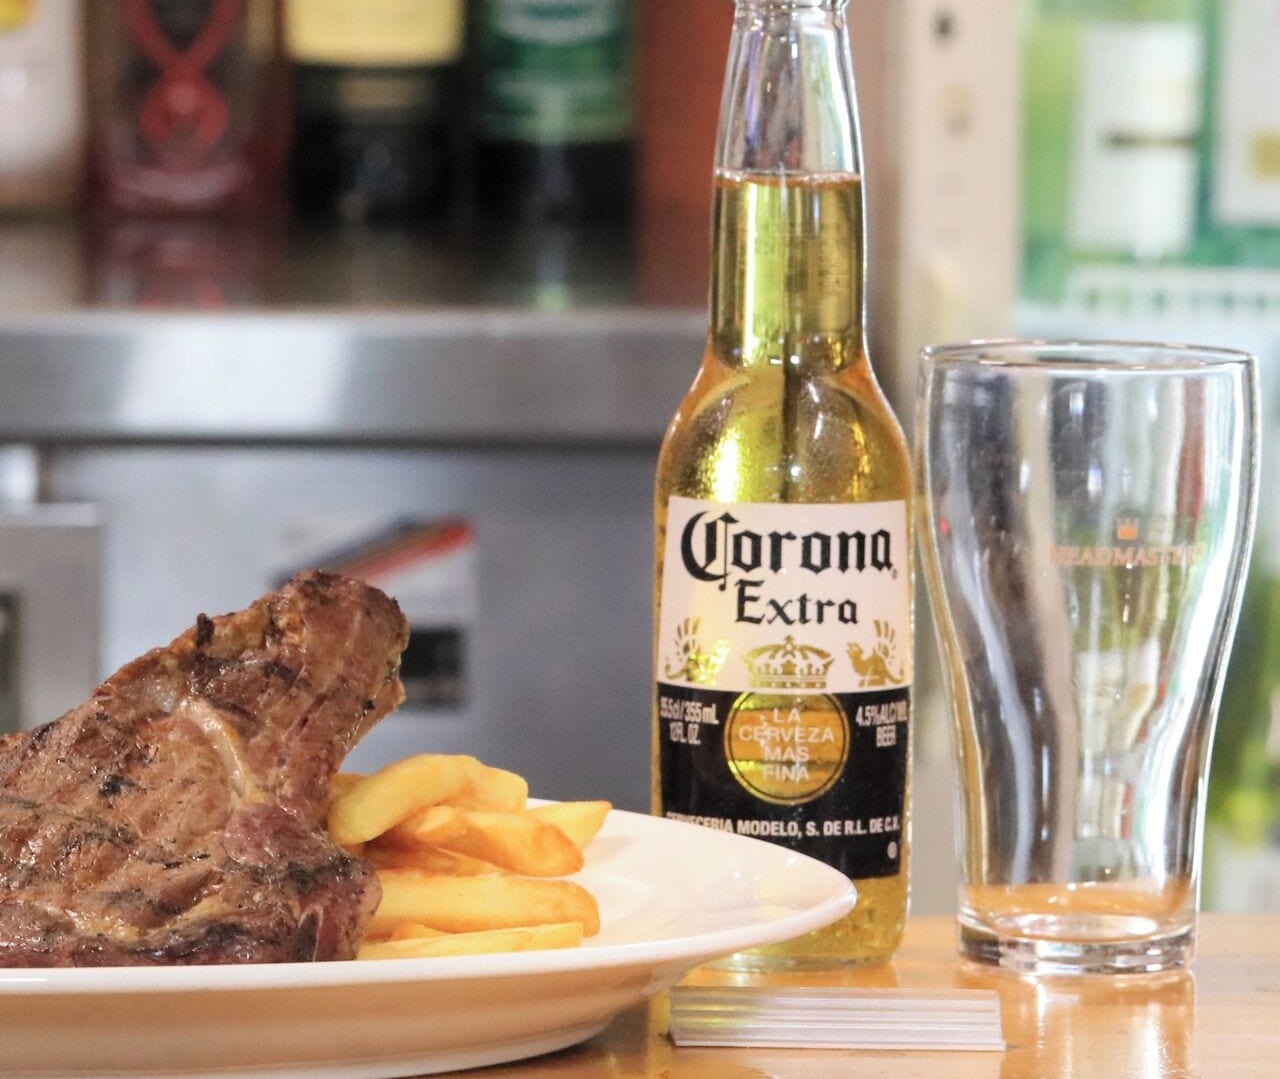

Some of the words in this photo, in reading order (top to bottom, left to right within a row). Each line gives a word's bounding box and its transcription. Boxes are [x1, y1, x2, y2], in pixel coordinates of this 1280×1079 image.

[681, 511, 894, 592] Corona
[734, 579, 858, 625] Extra
[773, 707, 801, 723] LA
[739, 725, 834, 742] CERVEZA
[764, 746, 810, 762] MAS
[763, 765, 810, 782] FINA
[736, 819, 802, 839] MODELO,
[805, 821, 820, 837] S.
[823, 820, 842, 836] DE
[869, 818, 883, 834] DE
